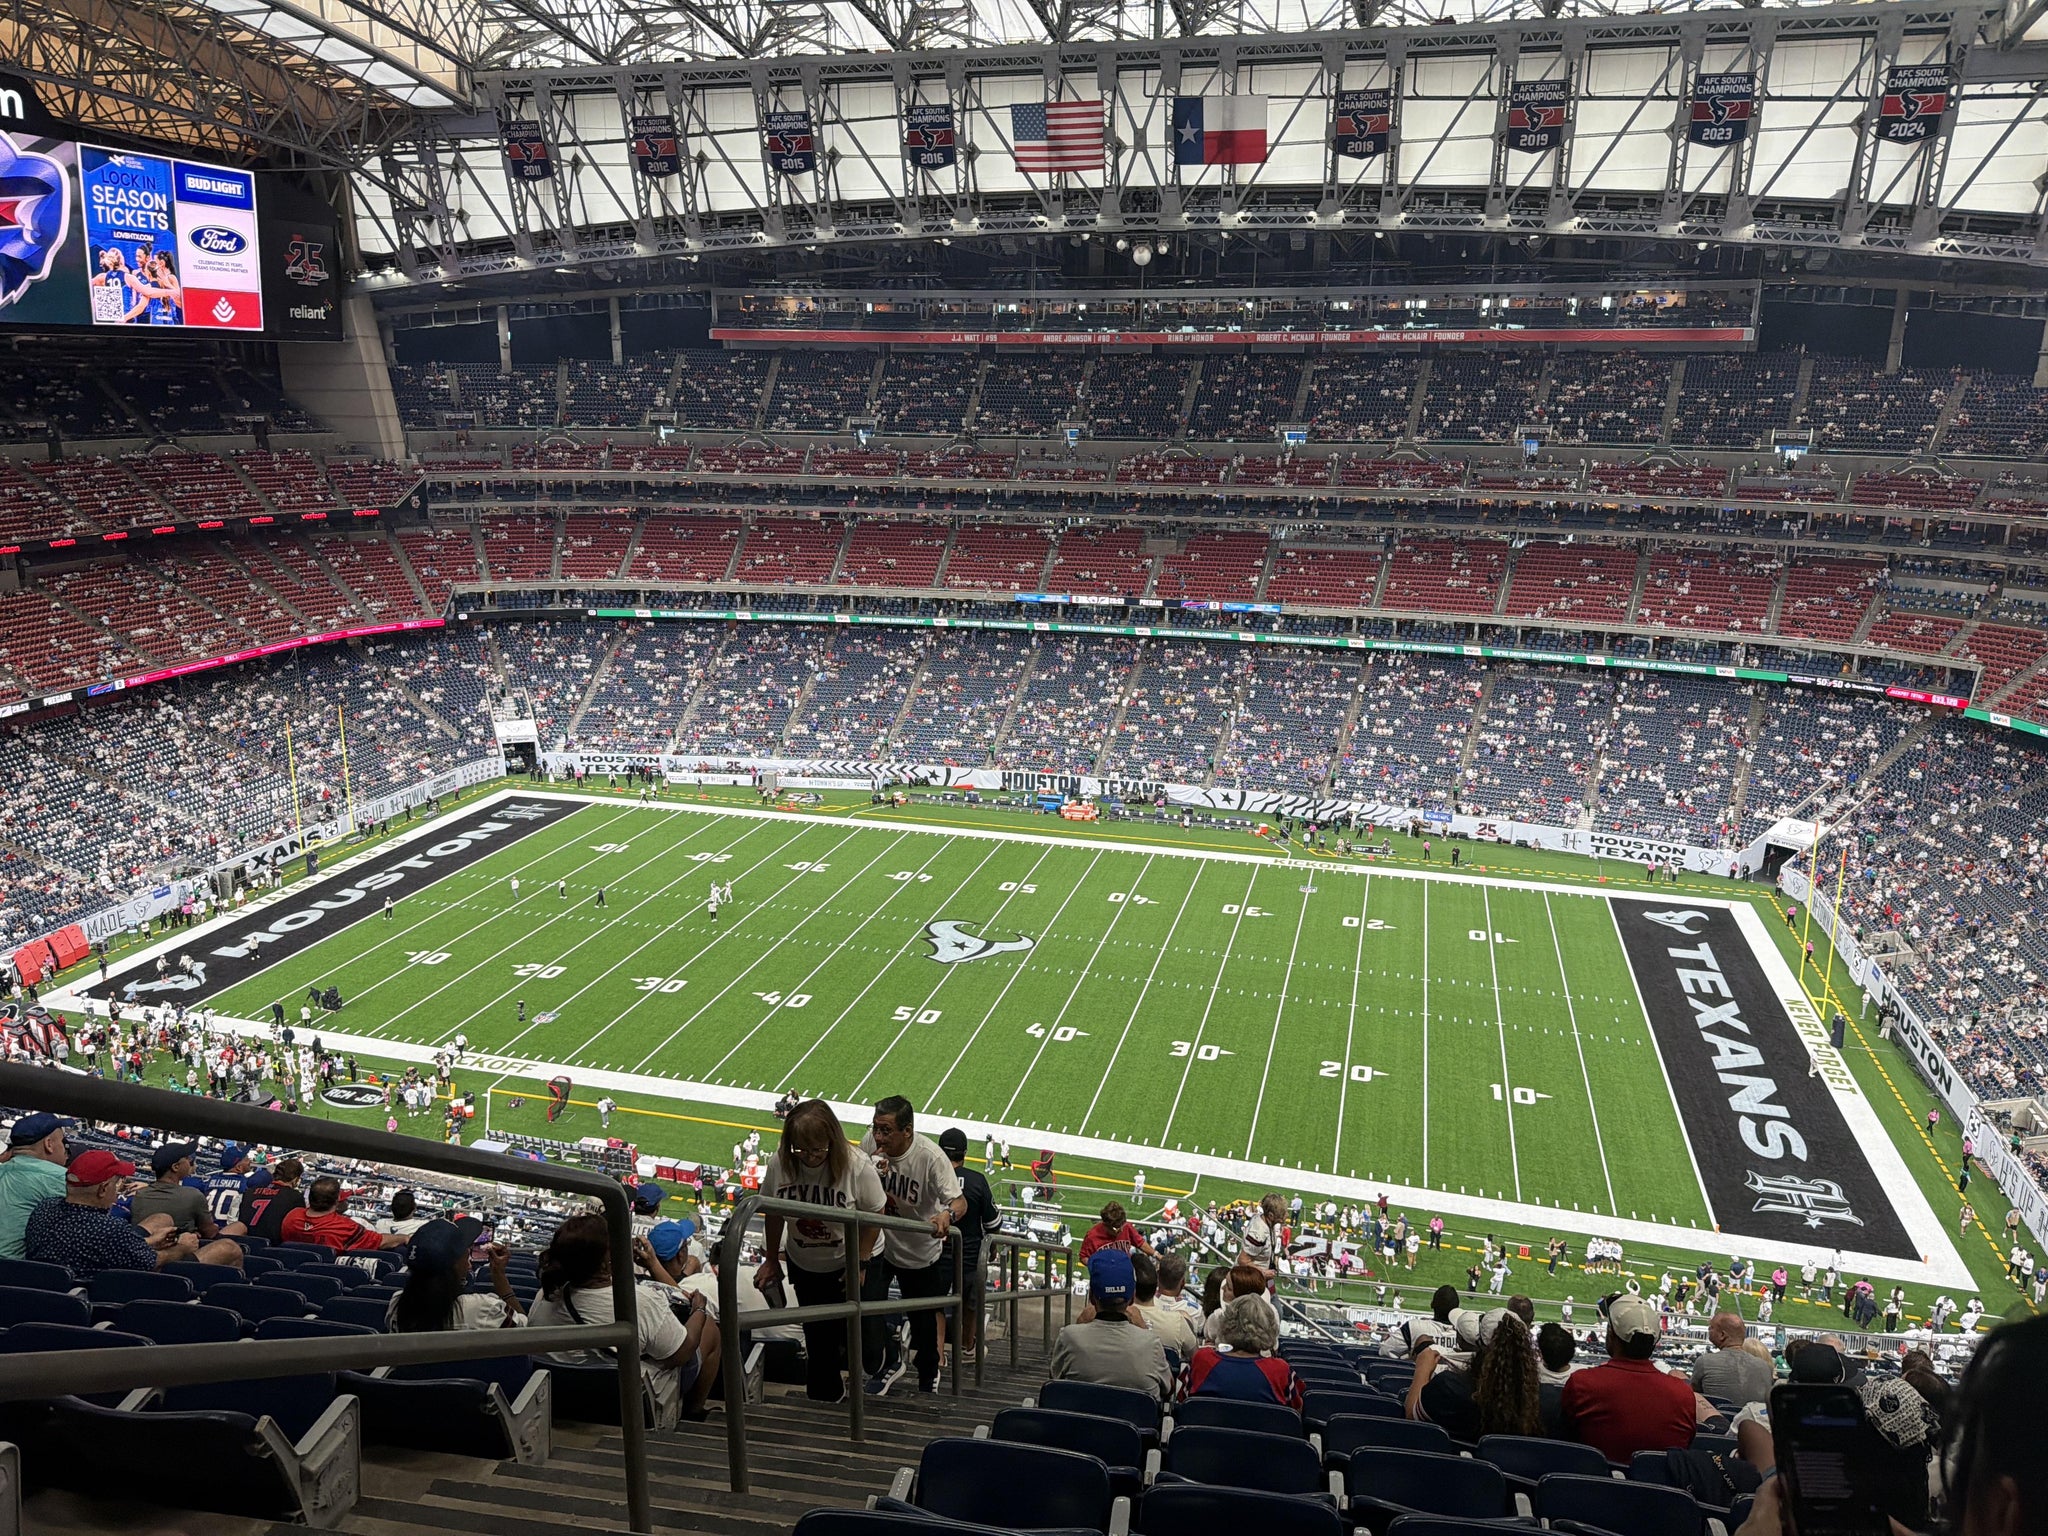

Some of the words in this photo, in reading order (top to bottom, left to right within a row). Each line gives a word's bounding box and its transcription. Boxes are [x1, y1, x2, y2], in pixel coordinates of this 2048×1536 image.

[1916, 68, 1944, 76] SOUTH
[1722, 76, 1747, 84] SOUTH
[1889, 76, 1949, 88] CHAMPIONS
[1513, 91, 1565, 101] CHAMPIONS
[1697, 84, 1751, 94] CHAMPIONS
[1338, 100, 1388, 110] CHAMPIONS
[908, 114, 950, 123] CHAMPIONS
[634, 126, 671, 134] CHAMPIONS
[767, 122, 808, 130] CHAMPIONS
[1888, 122, 1926, 137] 2024
[1520, 134, 1548, 146] 2019
[1702, 128, 1732, 140] 2023
[1348, 141, 1374, 152] 2018
[781, 158, 804, 169] 2015
[920, 152, 944, 164] 2016
[523, 165, 541, 176] 2011
[648, 162, 670, 172] 2012
[101, 169, 140, 188] LOCK
[142, 176, 156, 190] IN
[187, 177, 211, 190] BUD
[211, 181, 242, 195] LIGHT
[92, 185, 168, 211] SEASON
[93, 205, 169, 230] TICKETS
[200, 229, 237, 251] Ford
[289, 241, 324, 281] 25
[290, 305, 326, 320] reliant
[964, 334, 980, 342] WATT
[1167, 334, 1183, 342] RING
[1191, 334, 1214, 342] HONOR
[1290, 333, 1315, 341] MCNAIR
[1321, 333, 1350, 341] FOUNDER
[1433, 332, 1465, 340] FOUNDER
[249, 516, 274, 524] verizon
[301, 512, 327, 520] verizon
[353, 509, 380, 517] verizon
[151, 526, 176, 535] verizon
[198, 521, 224, 529] verizon
[49, 539, 76, 548] verizon
[102, 532, 128, 541] verizon
[43, 692, 73, 706] PREGAME
[580, 755, 660, 766] HOUSTON
[726, 761, 742, 771] 25
[581, 764, 659, 775] TEXAS
[1001, 771, 1081, 794] HOUSTON
[1097, 779, 1166, 795] TEXANS
[324, 822, 338, 836] 25
[1476, 822, 1499, 838] 25
[1590, 835, 1687, 856] HOUSTON
[1590, 845, 1684, 866] TEXANS
[1274, 858, 1354, 871] KICKOFF
[210, 822, 513, 958] HOUSTON
[87, 909, 128, 938] MADE
[407, 950, 453, 965] 10
[513, 963, 568, 979] 20
[635, 976, 689, 993] 30
[762, 990, 813, 1008] 40
[890, 1005, 943, 1025] 50
[1025, 1022, 1078, 1042] 40
[1783, 998, 1823, 1042] NEVER
[1807, 1040, 1859, 1095] FORGET
[1881, 985, 1952, 1096] HOUSTON
[1169, 1041, 1221, 1061] 30
[1667, 942, 1808, 1162] TEXANS
[455, 1055, 538, 1073] CKOFF
[1319, 1060, 1373, 1083] 20
[1489, 1083, 1537, 1105] 10
[208, 1178, 241, 1189] BILLSMAFIA
[253, 1187, 280, 1196] STROUD
[776, 1184, 847, 1208] TEXANS
[206, 1189, 243, 1221] 10
[250, 1199, 271, 1226] 7
[1295, 1235, 1364, 1269] 25
